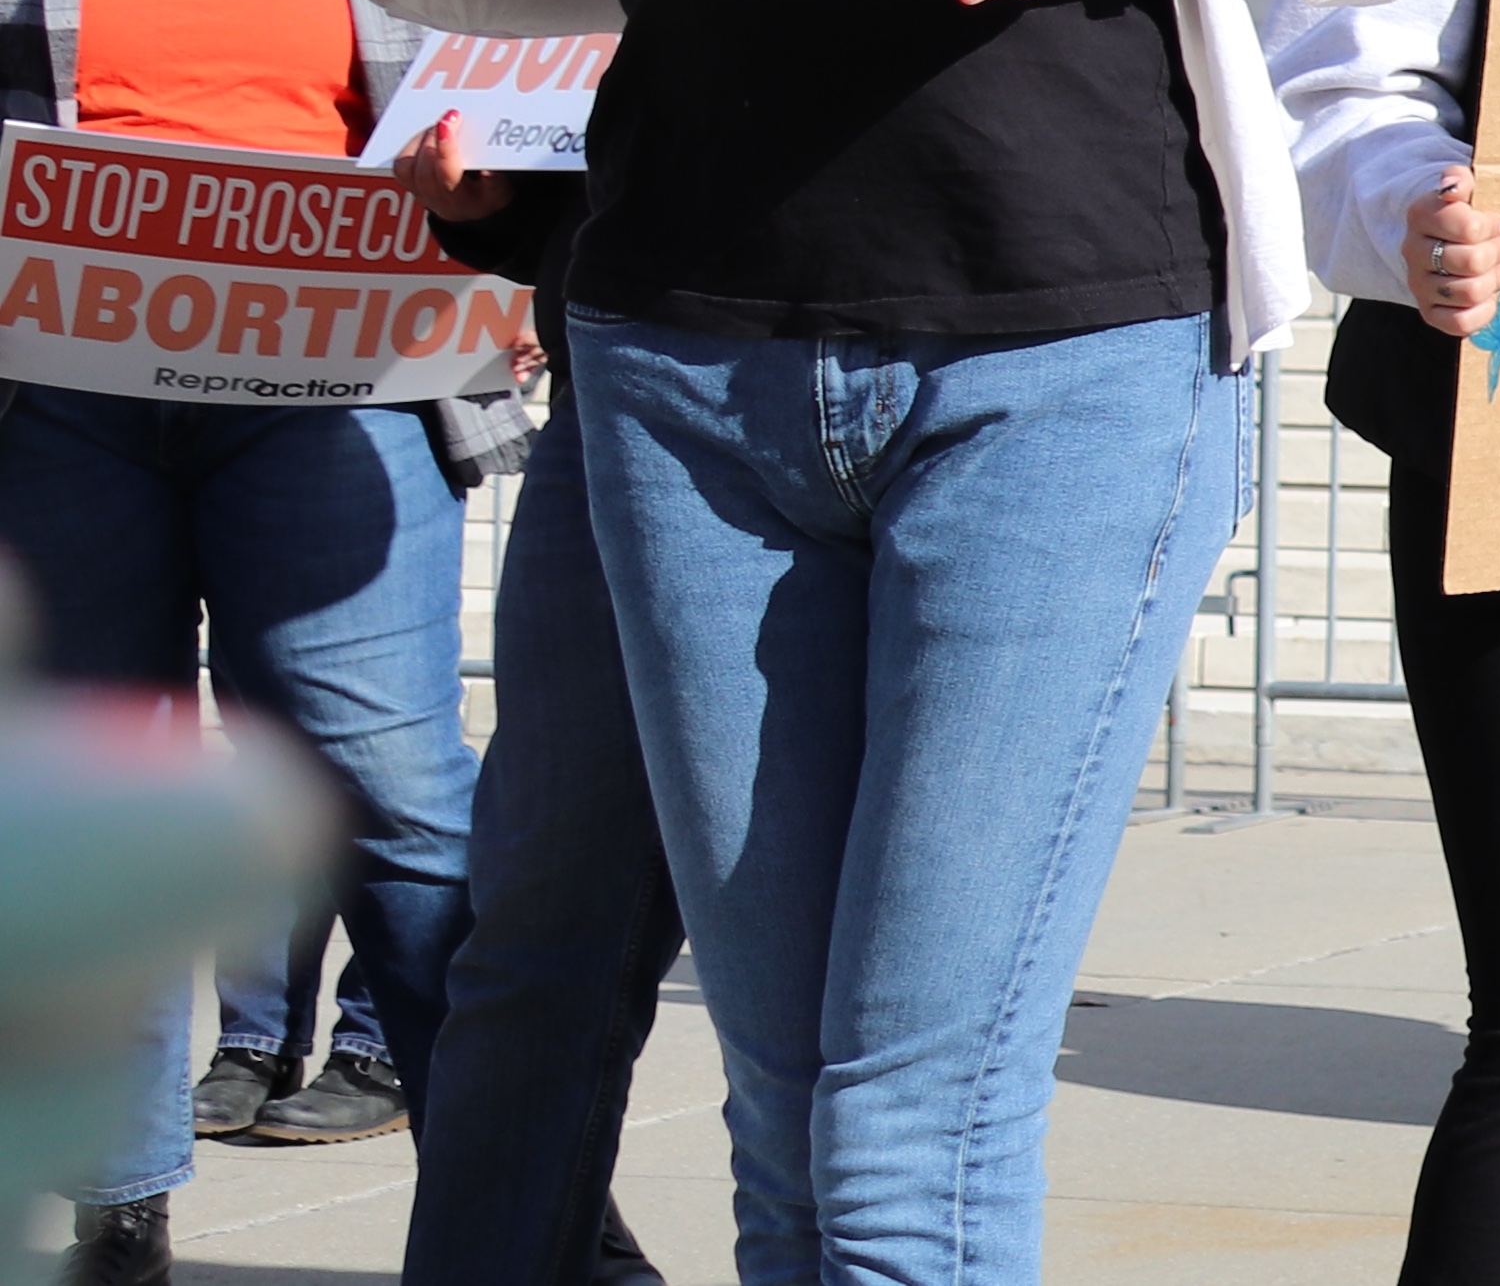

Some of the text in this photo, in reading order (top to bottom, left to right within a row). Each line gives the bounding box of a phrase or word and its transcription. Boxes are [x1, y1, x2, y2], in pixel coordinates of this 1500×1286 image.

[15, 154, 450, 262] STOP PROSECU
[0, 256, 536, 360] ABORTION
